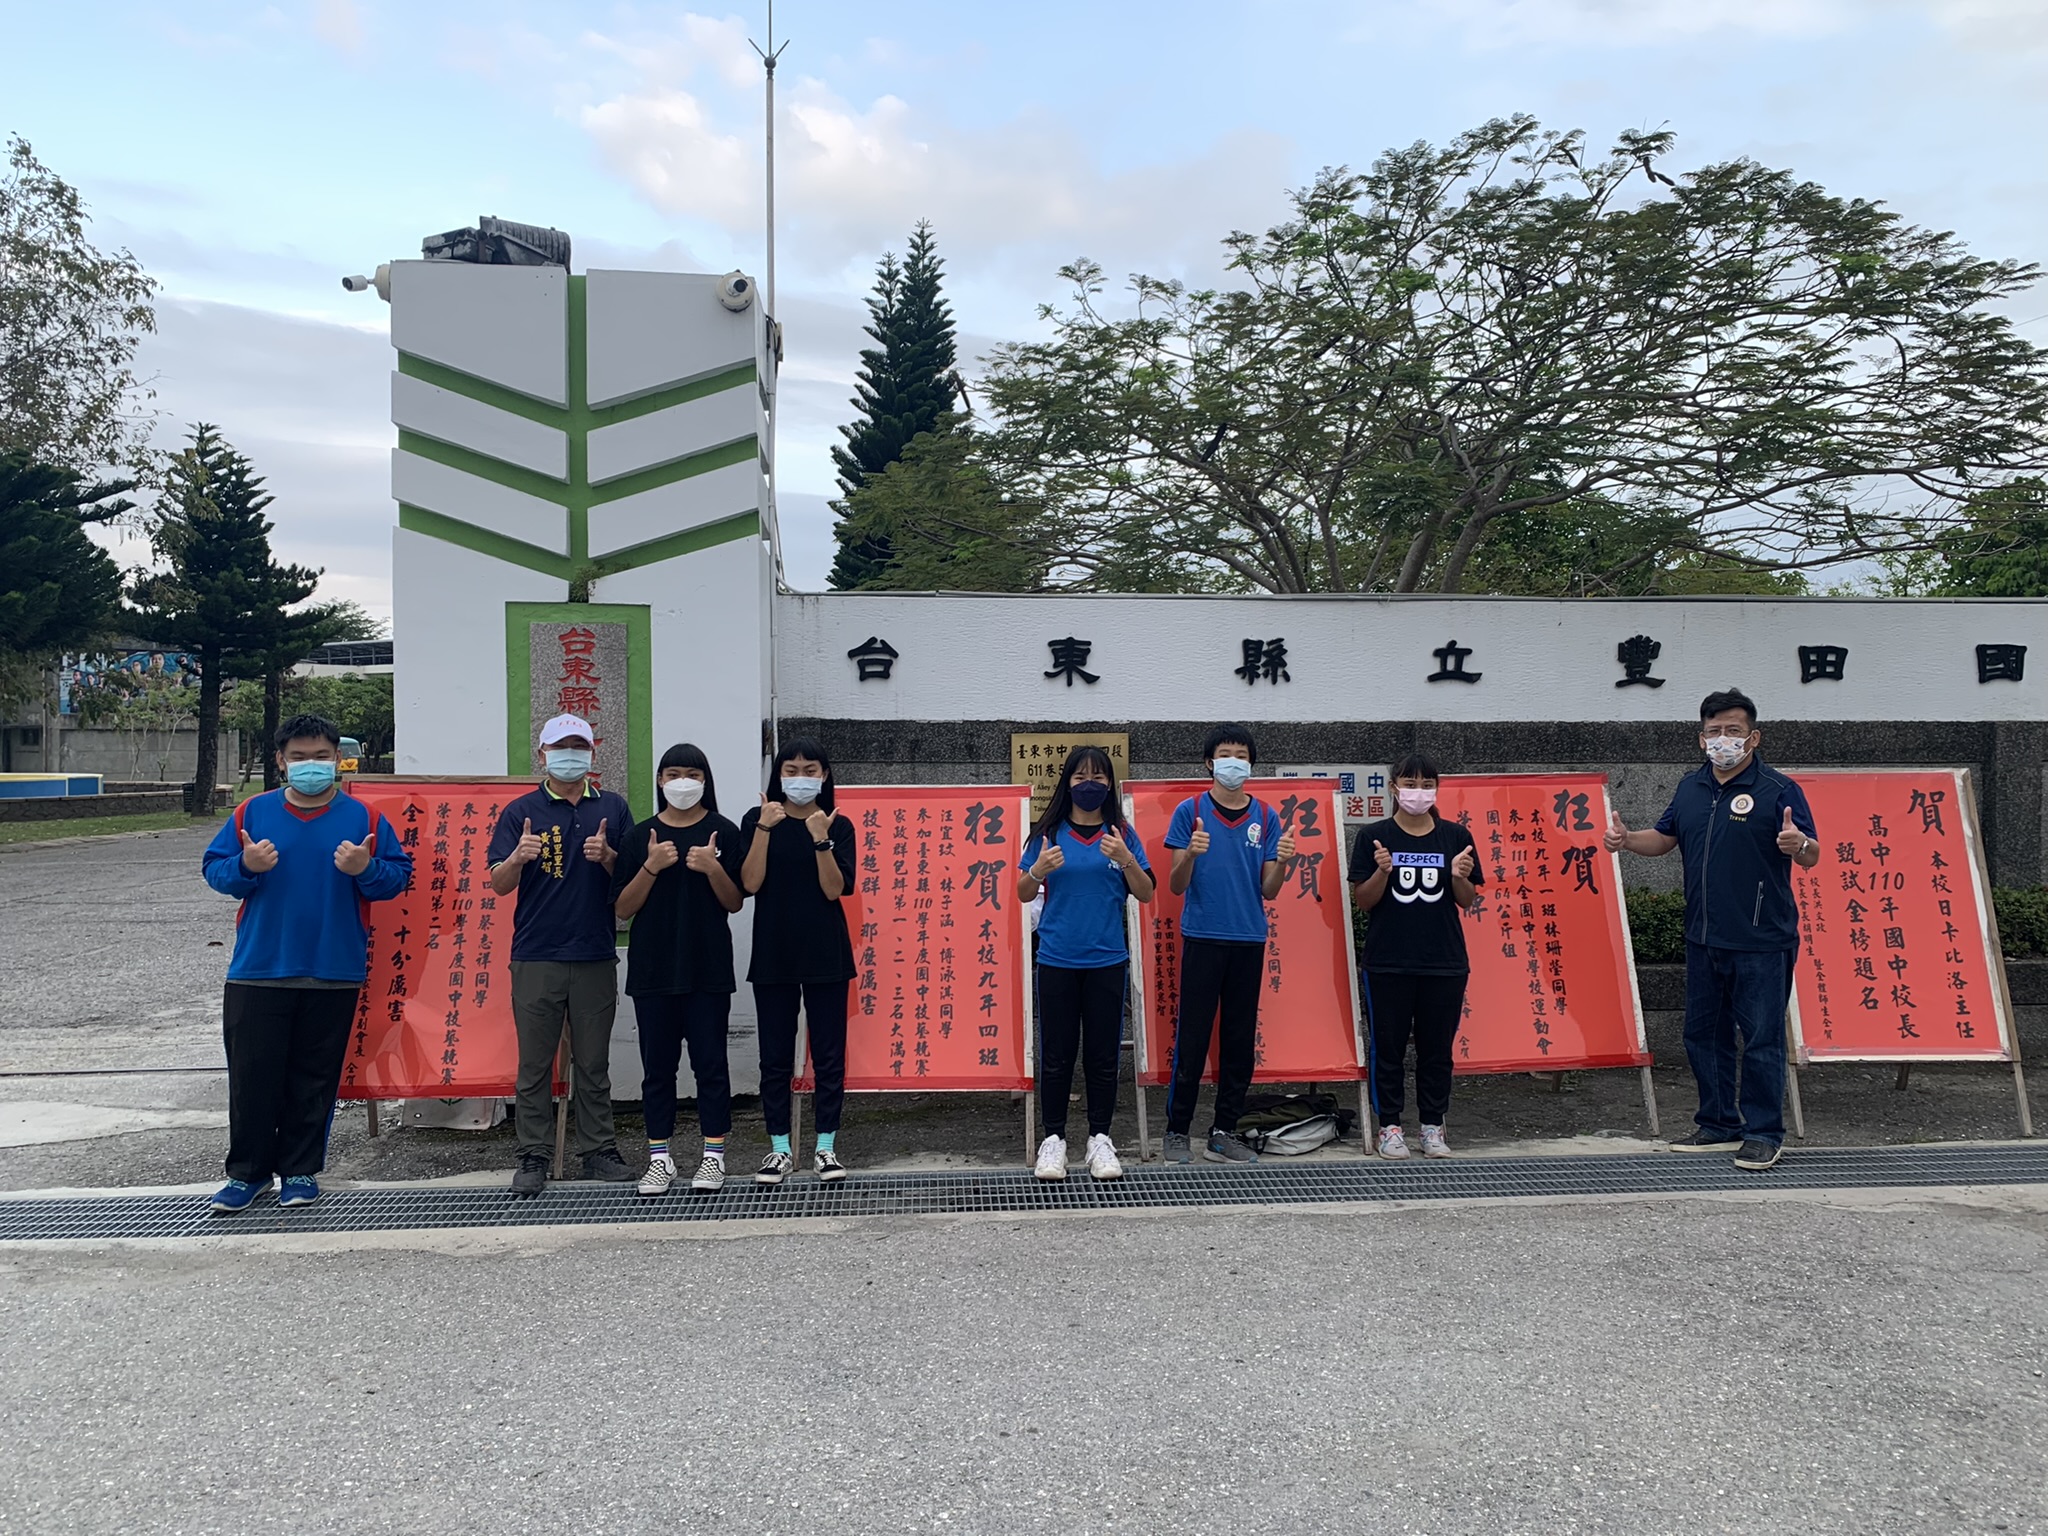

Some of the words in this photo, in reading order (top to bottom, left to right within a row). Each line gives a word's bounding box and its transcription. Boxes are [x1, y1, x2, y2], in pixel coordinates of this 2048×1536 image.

[1016, 744, 1123, 759] 臺東市中四段
[963, 801, 1007, 911] 狂賀
[1279, 794, 1328, 903] 狂賀
[1397, 853, 1441, 865] RESPECT
[1553, 788, 1600, 896] 狂賀
[1835, 842, 1879, 1010] 甄試金榜題名
[1907, 789, 1945, 836] 賀
[1930, 850, 1975, 1039] 本校日卡比洛主任
[976, 919, 1000, 1067] 本校九年四班
